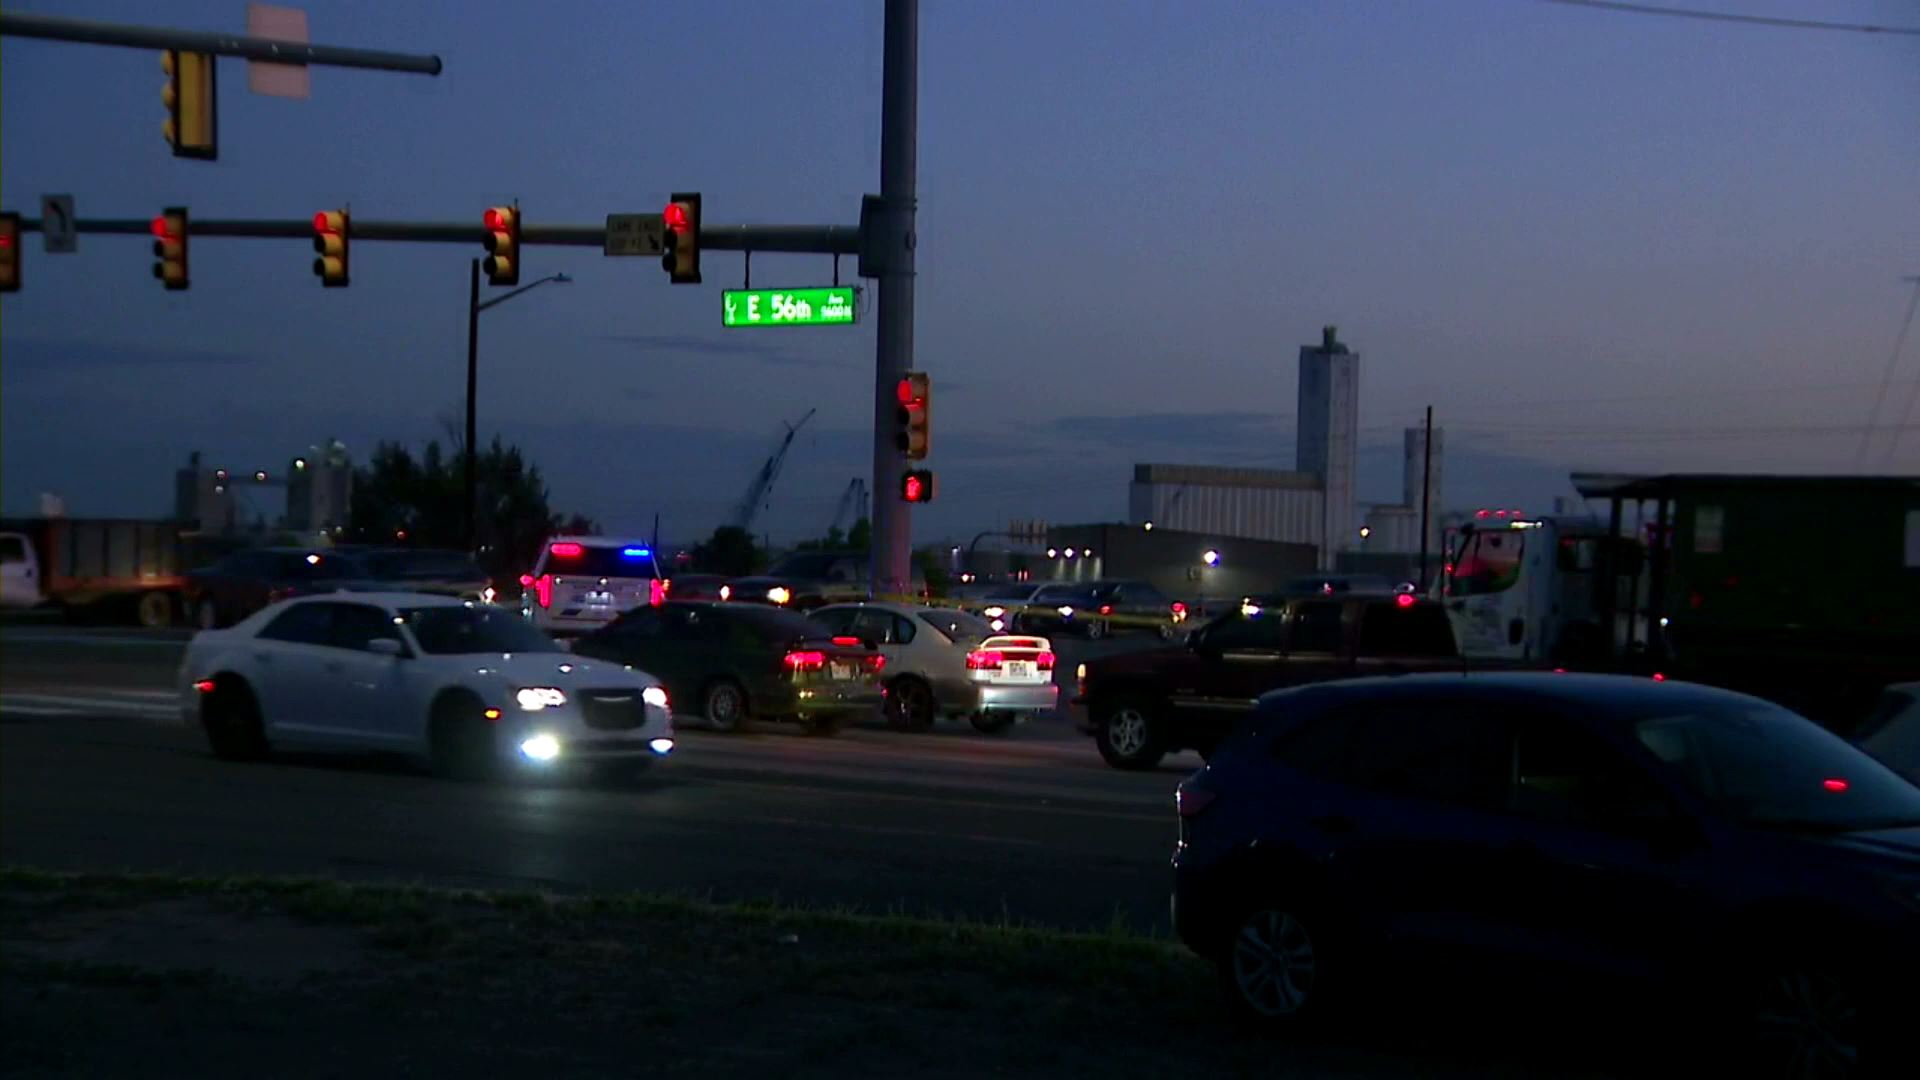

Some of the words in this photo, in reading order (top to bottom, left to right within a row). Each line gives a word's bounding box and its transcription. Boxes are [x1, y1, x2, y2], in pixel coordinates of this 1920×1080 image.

[747, 294, 761, 321] E
[771, 293, 812, 321] 56th
[828, 292, 844, 305] Ave
